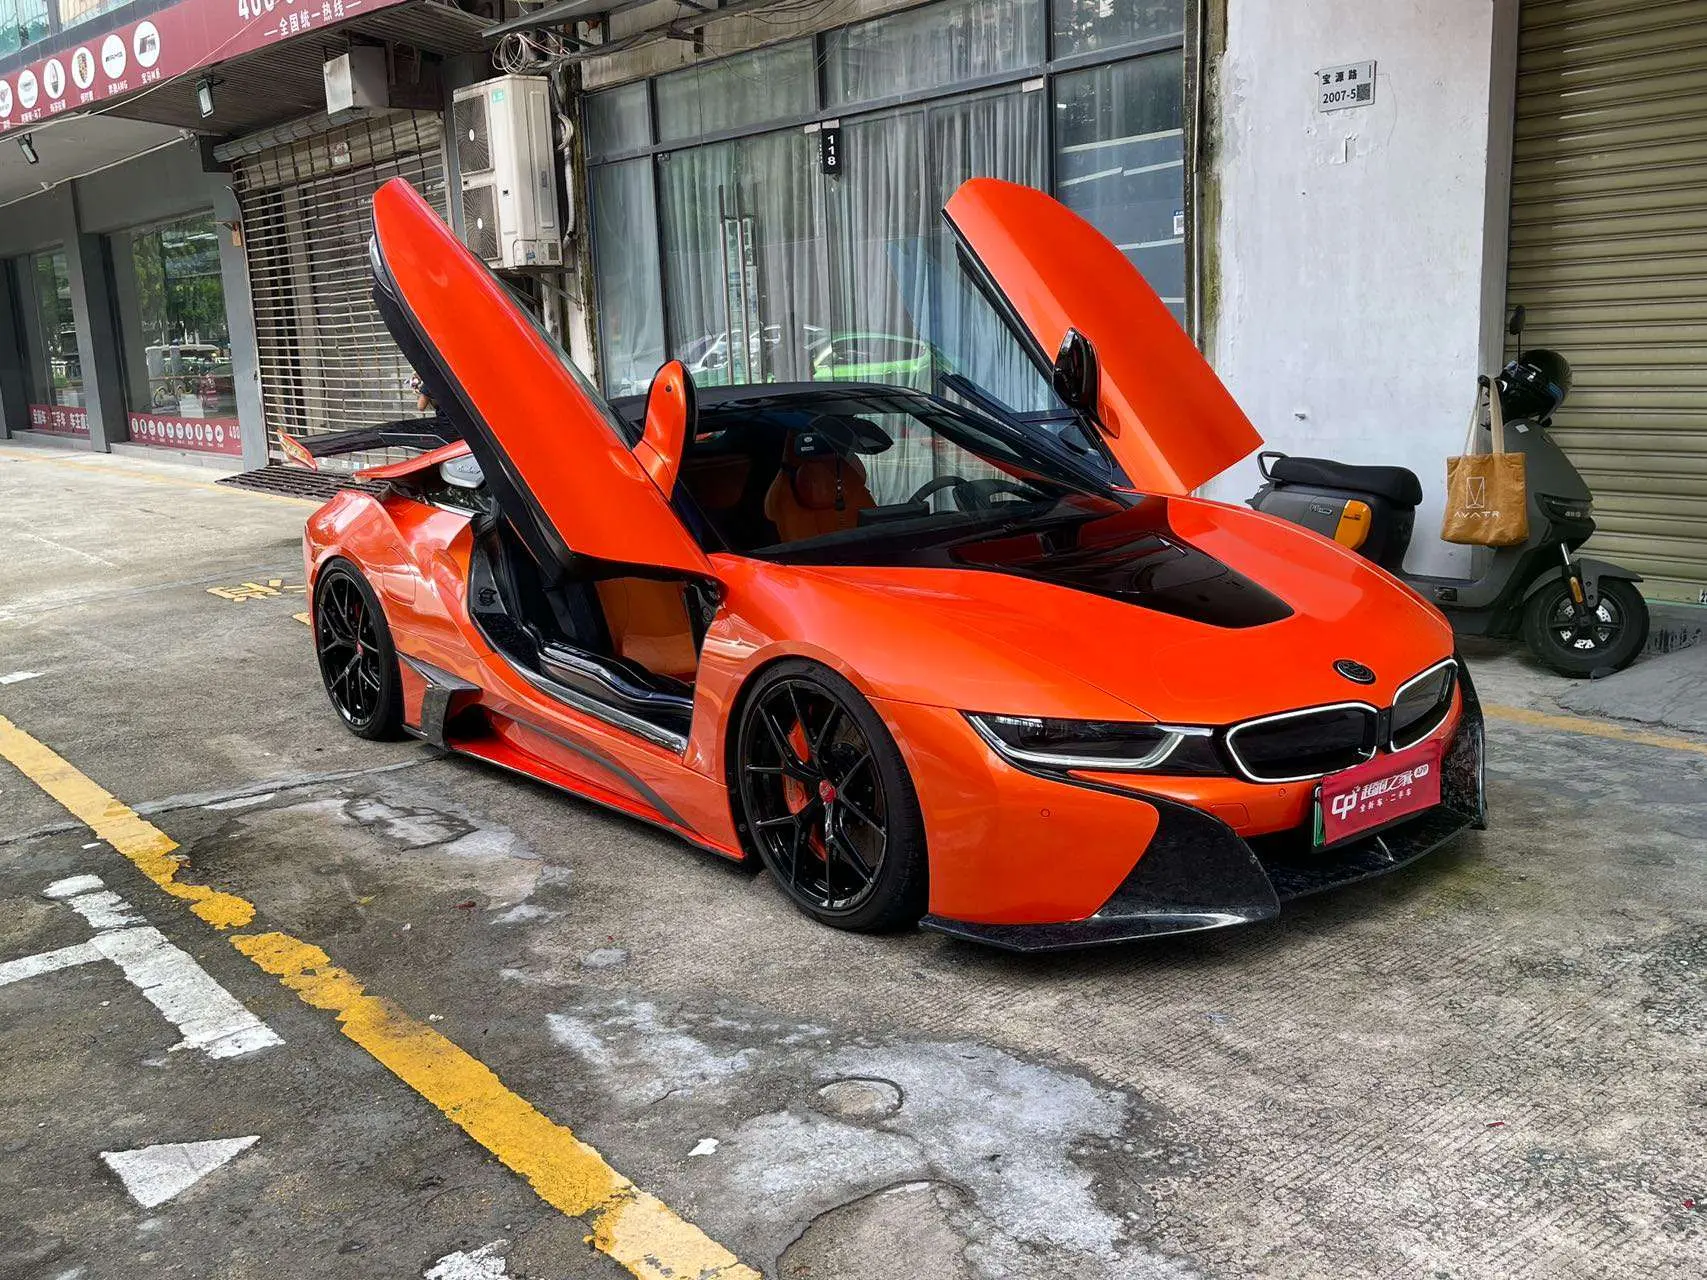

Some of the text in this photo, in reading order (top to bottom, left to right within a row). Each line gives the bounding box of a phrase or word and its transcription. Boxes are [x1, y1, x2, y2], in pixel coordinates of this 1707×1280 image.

[279, 0, 345, 36] 全国统一热线
[1323, 88, 1356, 104] 2007-5
[827, 134, 836, 166] 118
